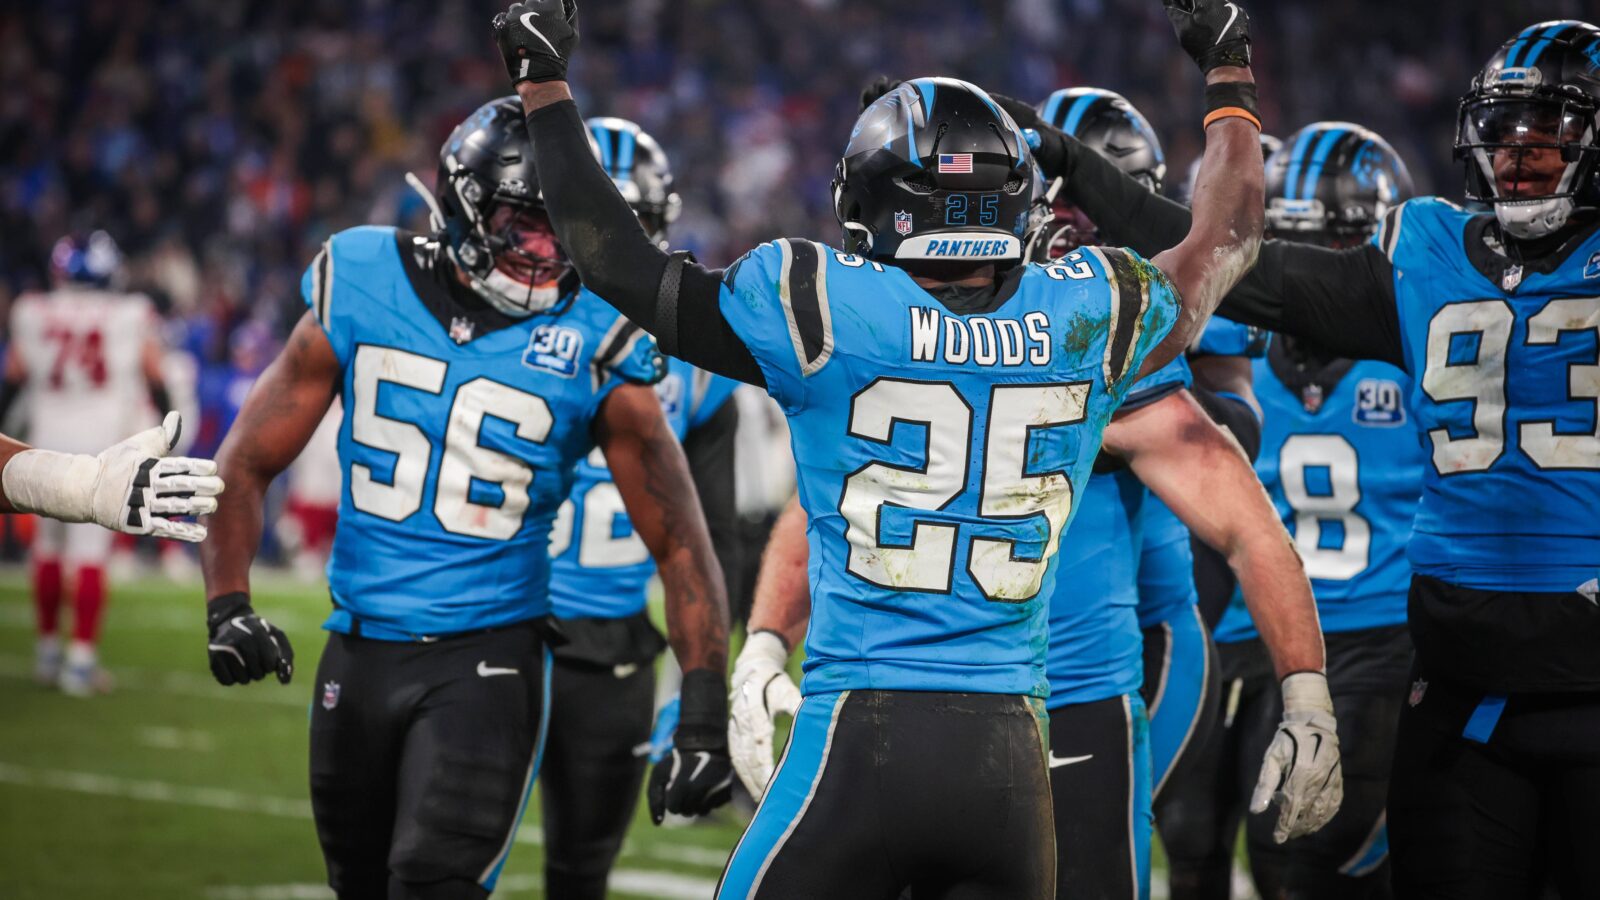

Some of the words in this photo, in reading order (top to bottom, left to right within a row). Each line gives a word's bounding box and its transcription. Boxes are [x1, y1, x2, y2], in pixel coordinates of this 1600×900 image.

[945, 193, 999, 226] 25
[925, 239, 1009, 257] PANTHERS
[42, 326, 107, 389] 74
[534, 324, 577, 361] 30
[909, 305, 1051, 367] WOODS
[1360, 381, 1397, 410] 30
[1421, 295, 1600, 478] 93
[350, 343, 555, 541] 56
[838, 375, 1093, 604] 25
[1279, 433, 1371, 580] 8
